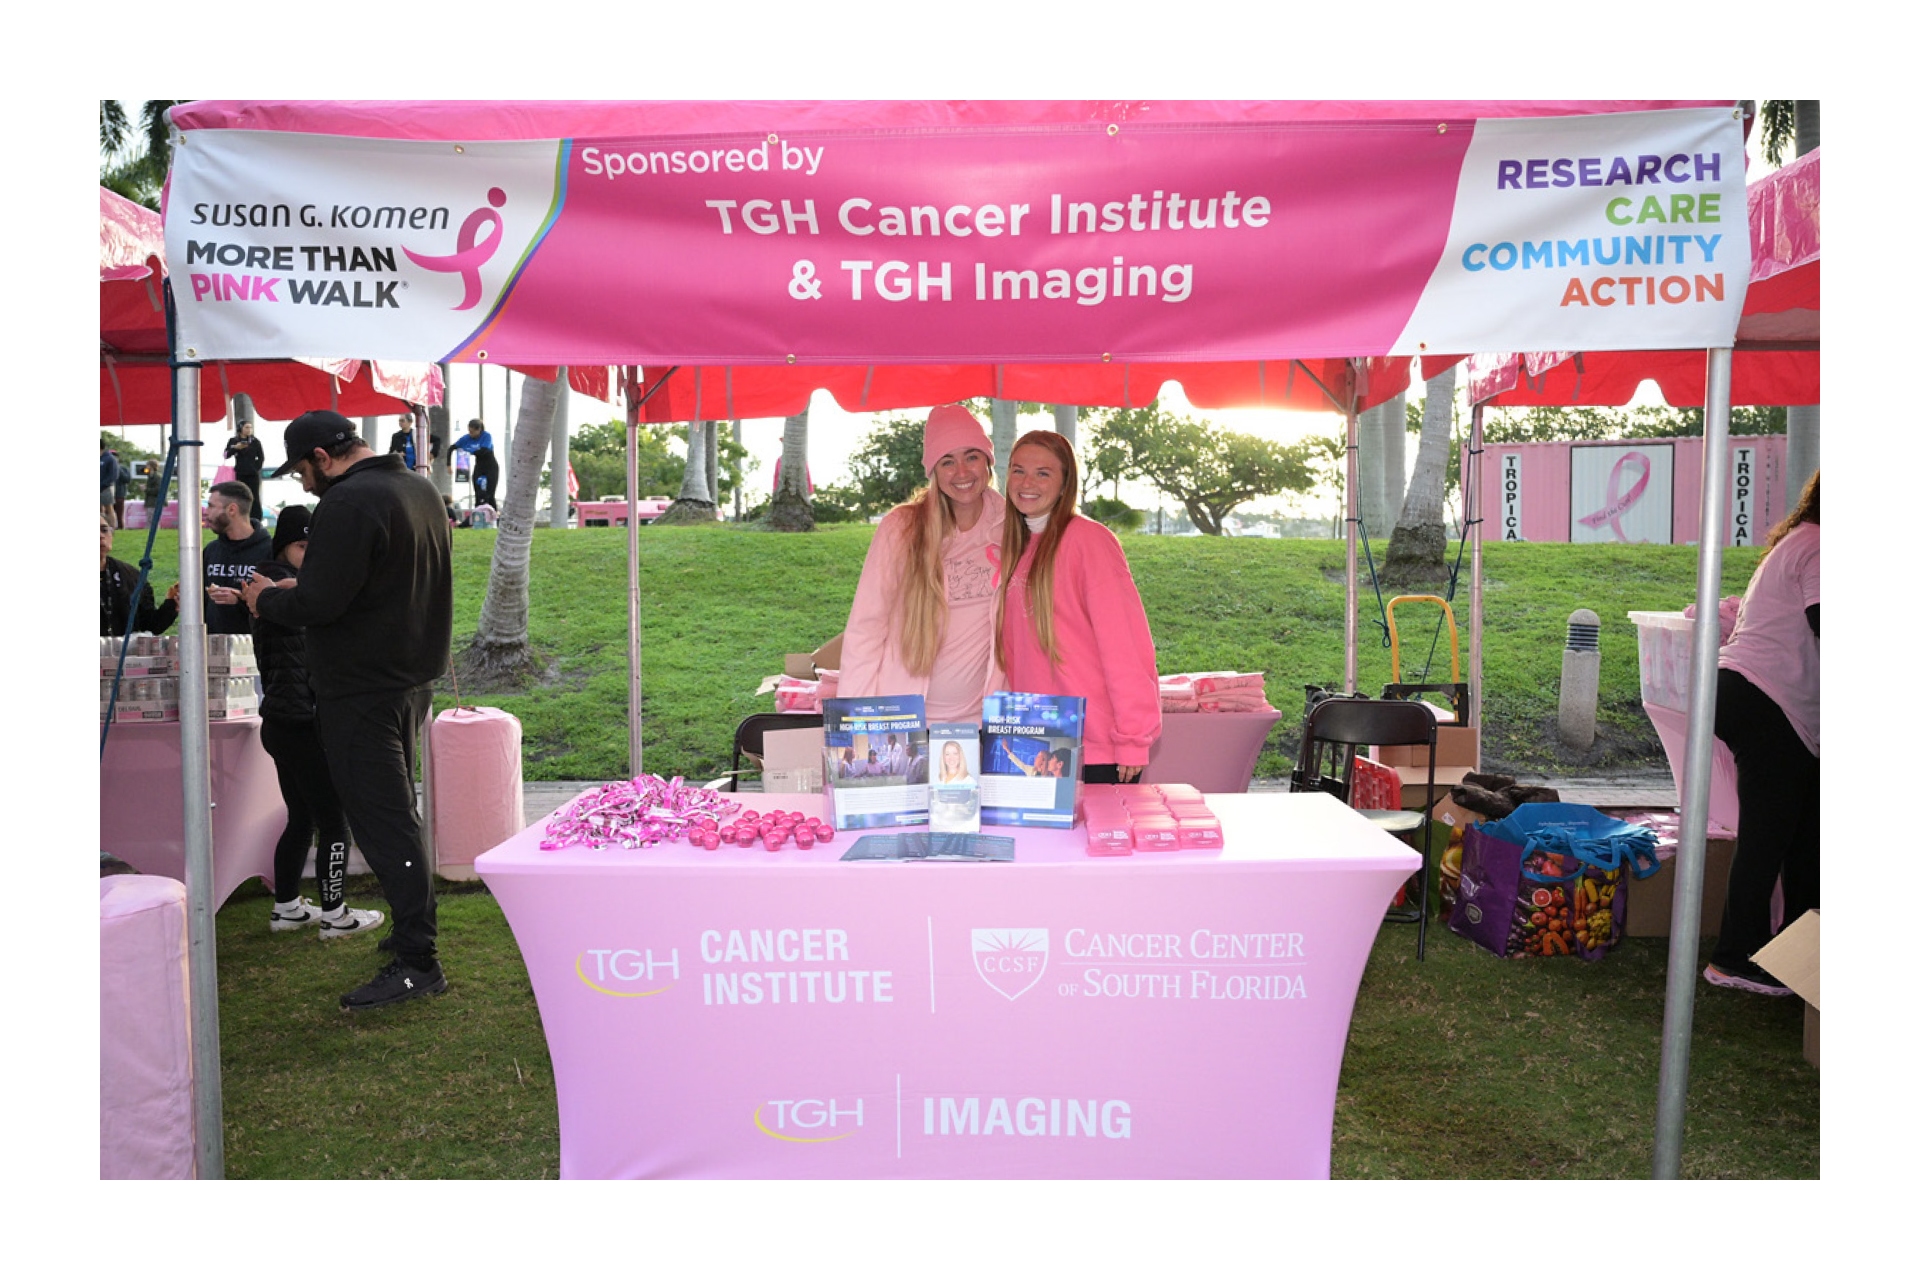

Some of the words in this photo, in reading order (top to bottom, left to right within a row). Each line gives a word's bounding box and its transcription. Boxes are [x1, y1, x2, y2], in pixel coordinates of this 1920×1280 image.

[580, 140, 769, 180] Sponsored
[781, 140, 825, 176] by
[1497, 152, 1721, 190] RESEARCH
[705, 198, 820, 235] TGH
[838, 197, 1030, 237] Cancer
[1050, 190, 1271, 235] Institute
[1605, 193, 1722, 226] CARE
[187, 239, 294, 271] MORE
[300, 246, 398, 272] THAN
[1461, 233, 1722, 272] COMMUNITY
[190, 273, 281, 303] PINK
[788, 259, 823, 301] &
[841, 260, 952, 302] TGH
[974, 255, 1194, 306] Imaging
[1560, 273, 1725, 307] ACTION
[1505, 455, 1517, 541] TROPICA
[206, 563, 257, 577] CELSIUS
[890, 720, 920, 730] PROGRAM
[987, 725, 1011, 735] BREAST
[1013, 725, 1046, 736] PROGRAM
[988, 714, 1021, 725] HIGH-RISK
[329, 842, 345, 903] CELSIUS
[700, 928, 850, 964] CANCER
[1064, 928, 1183, 959] CANCER
[1190, 928, 1306, 959] CENTER
[587, 948, 680, 981] TGH
[983, 955, 1039, 974] CCSF
[702, 970, 894, 1005] INSTITUTE
[1057, 983, 1079, 997] OF
[1083, 968, 1182, 999] SOUTH
[1190, 970, 1308, 1000] FLORIDA
[768, 1098, 864, 1130] TGH
[923, 1097, 1131, 1139] IMAGING
